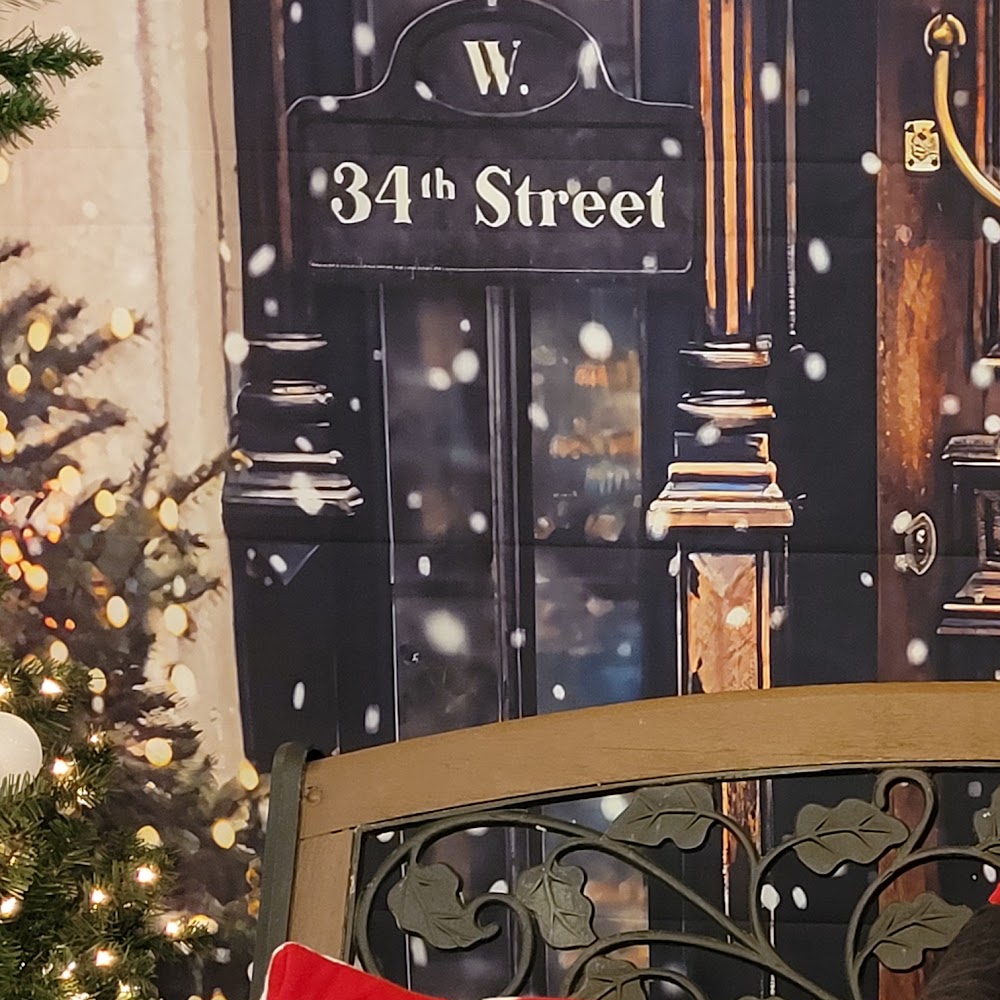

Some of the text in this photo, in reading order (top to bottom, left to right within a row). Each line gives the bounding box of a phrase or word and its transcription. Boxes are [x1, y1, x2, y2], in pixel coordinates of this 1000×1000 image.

[462, 40, 529, 96] W.
[330, 161, 666, 229] 34th Street
